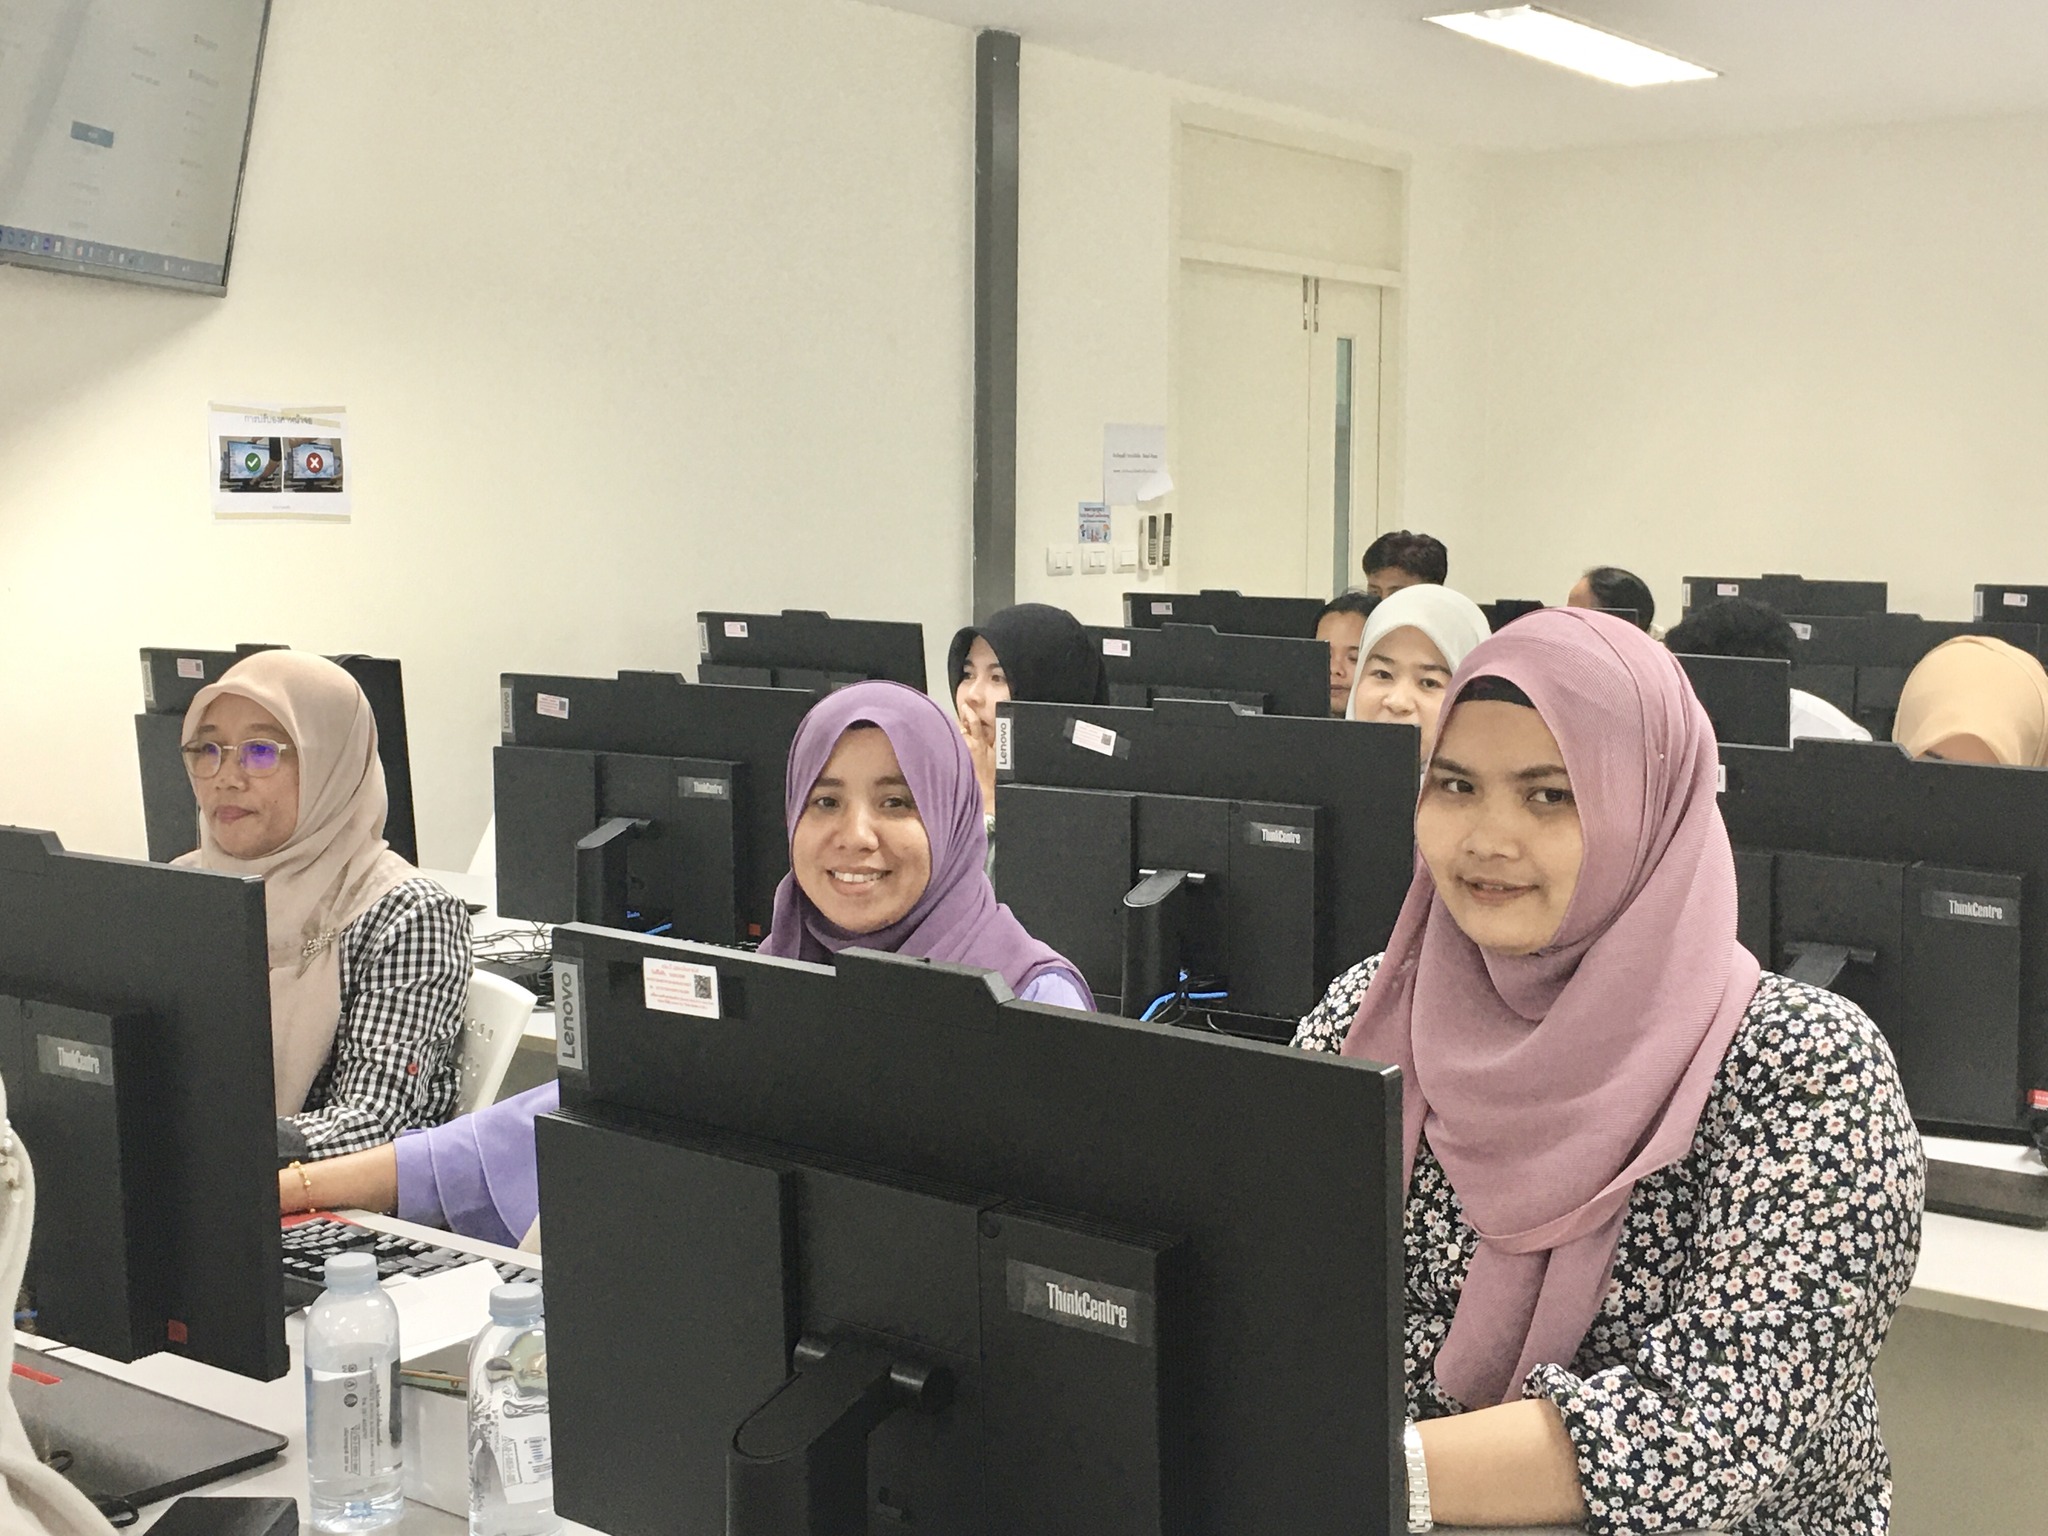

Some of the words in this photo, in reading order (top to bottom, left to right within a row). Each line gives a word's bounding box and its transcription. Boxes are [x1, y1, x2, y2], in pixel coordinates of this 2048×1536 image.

[503, 691, 511, 729] Lenovo
[1949, 899, 2003, 920] ThinkCentre
[562, 972, 576, 1059] Lenovo
[1046, 1281, 1128, 1329] ThinkCentre
